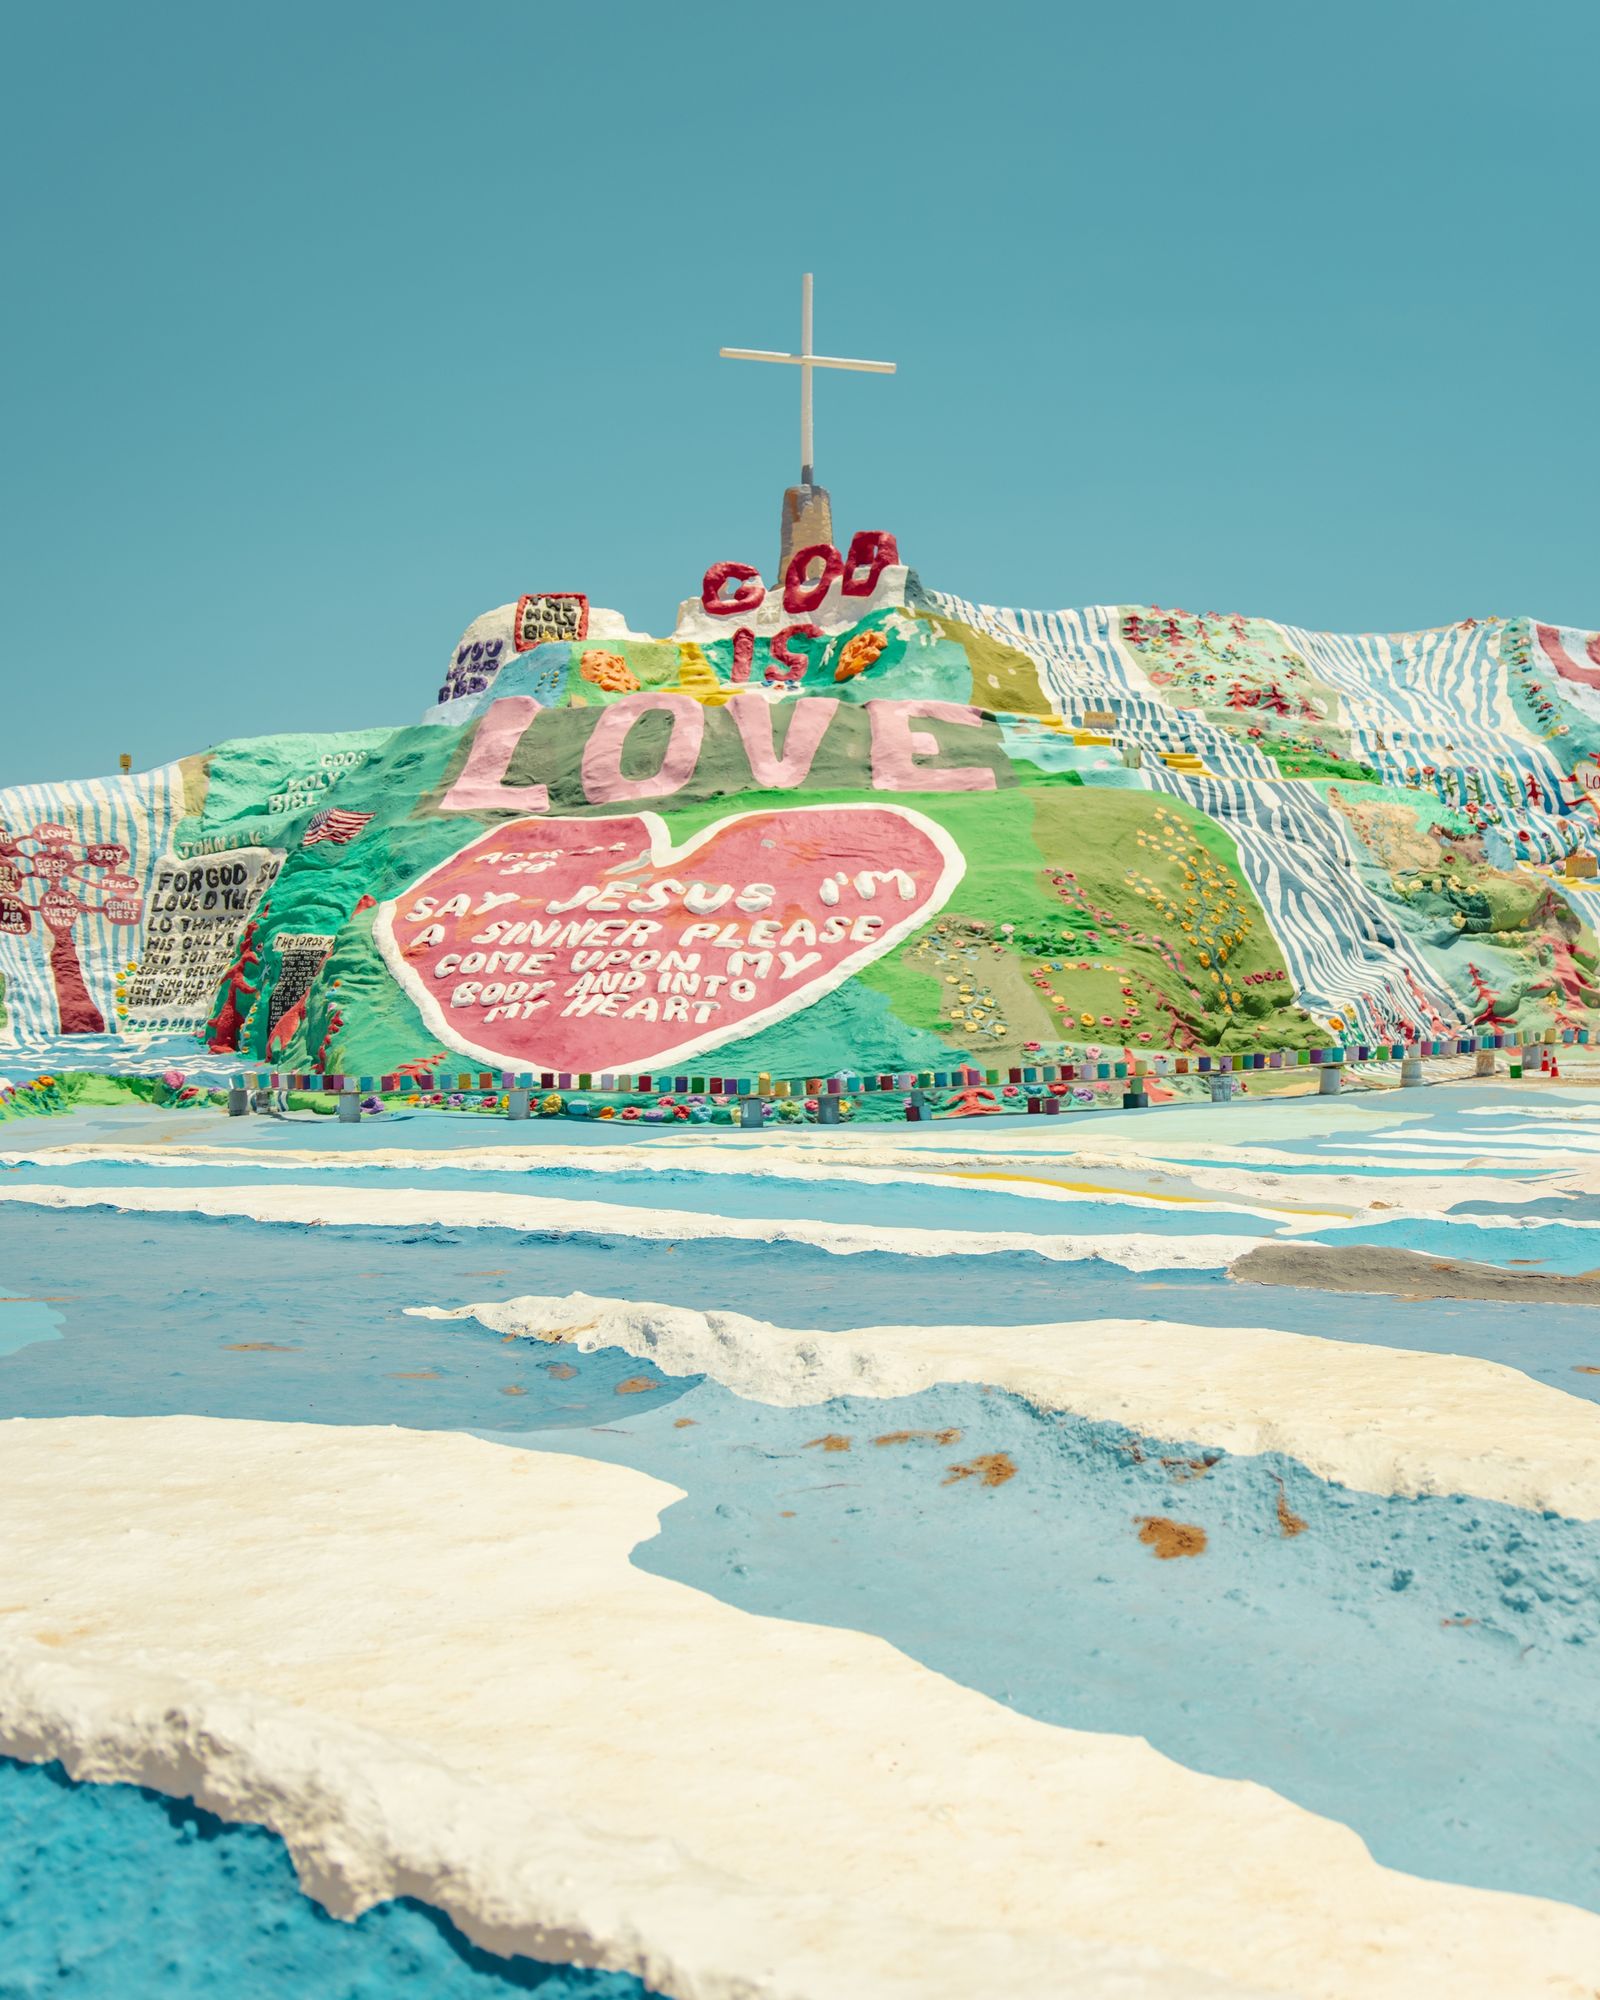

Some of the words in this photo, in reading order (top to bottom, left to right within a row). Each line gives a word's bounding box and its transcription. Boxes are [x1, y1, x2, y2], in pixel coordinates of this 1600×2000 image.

[702, 531, 899, 615] GOD
[526, 608, 577, 627] HOLY
[457, 639, 503, 665] YOU
[731, 624, 825, 683] IS
[438, 692, 998, 811] LOVE
[40, 829, 72, 840] LOVE
[94, 848, 122, 863] JOY
[178, 836, 226, 859] JOHN
[35, 858, 68, 868] GOOD
[101, 879, 136, 889] PEACE
[158, 866, 204, 892] FOR
[206, 862, 248, 888] GOD
[257, 861, 280, 884] SO
[405, 893, 520, 921] SAY
[546, 879, 776, 914] JESUS
[819, 869, 916, 906] I'M
[109, 911, 137, 919] NESS
[147, 936, 176, 951] HIS
[182, 932, 223, 949] ONLY
[410, 924, 445, 947] A
[471, 919, 662, 948] SINNER
[679, 915, 884, 948] PLEASE
[144, 953, 171, 965] TEN
[180, 951, 209, 964] SON
[434, 951, 556, 978] COME
[570, 950, 701, 973] UPON
[727, 951, 822, 980] MY
[156, 988, 180, 997] BUT
[159, 979, 204, 989] SHOULD
[450, 980, 555, 1008] BODY
[565, 971, 646, 997] AND
[658, 971, 756, 1001] INTO
[483, 1000, 550, 1023] MY
[560, 993, 721, 1023] HEART
